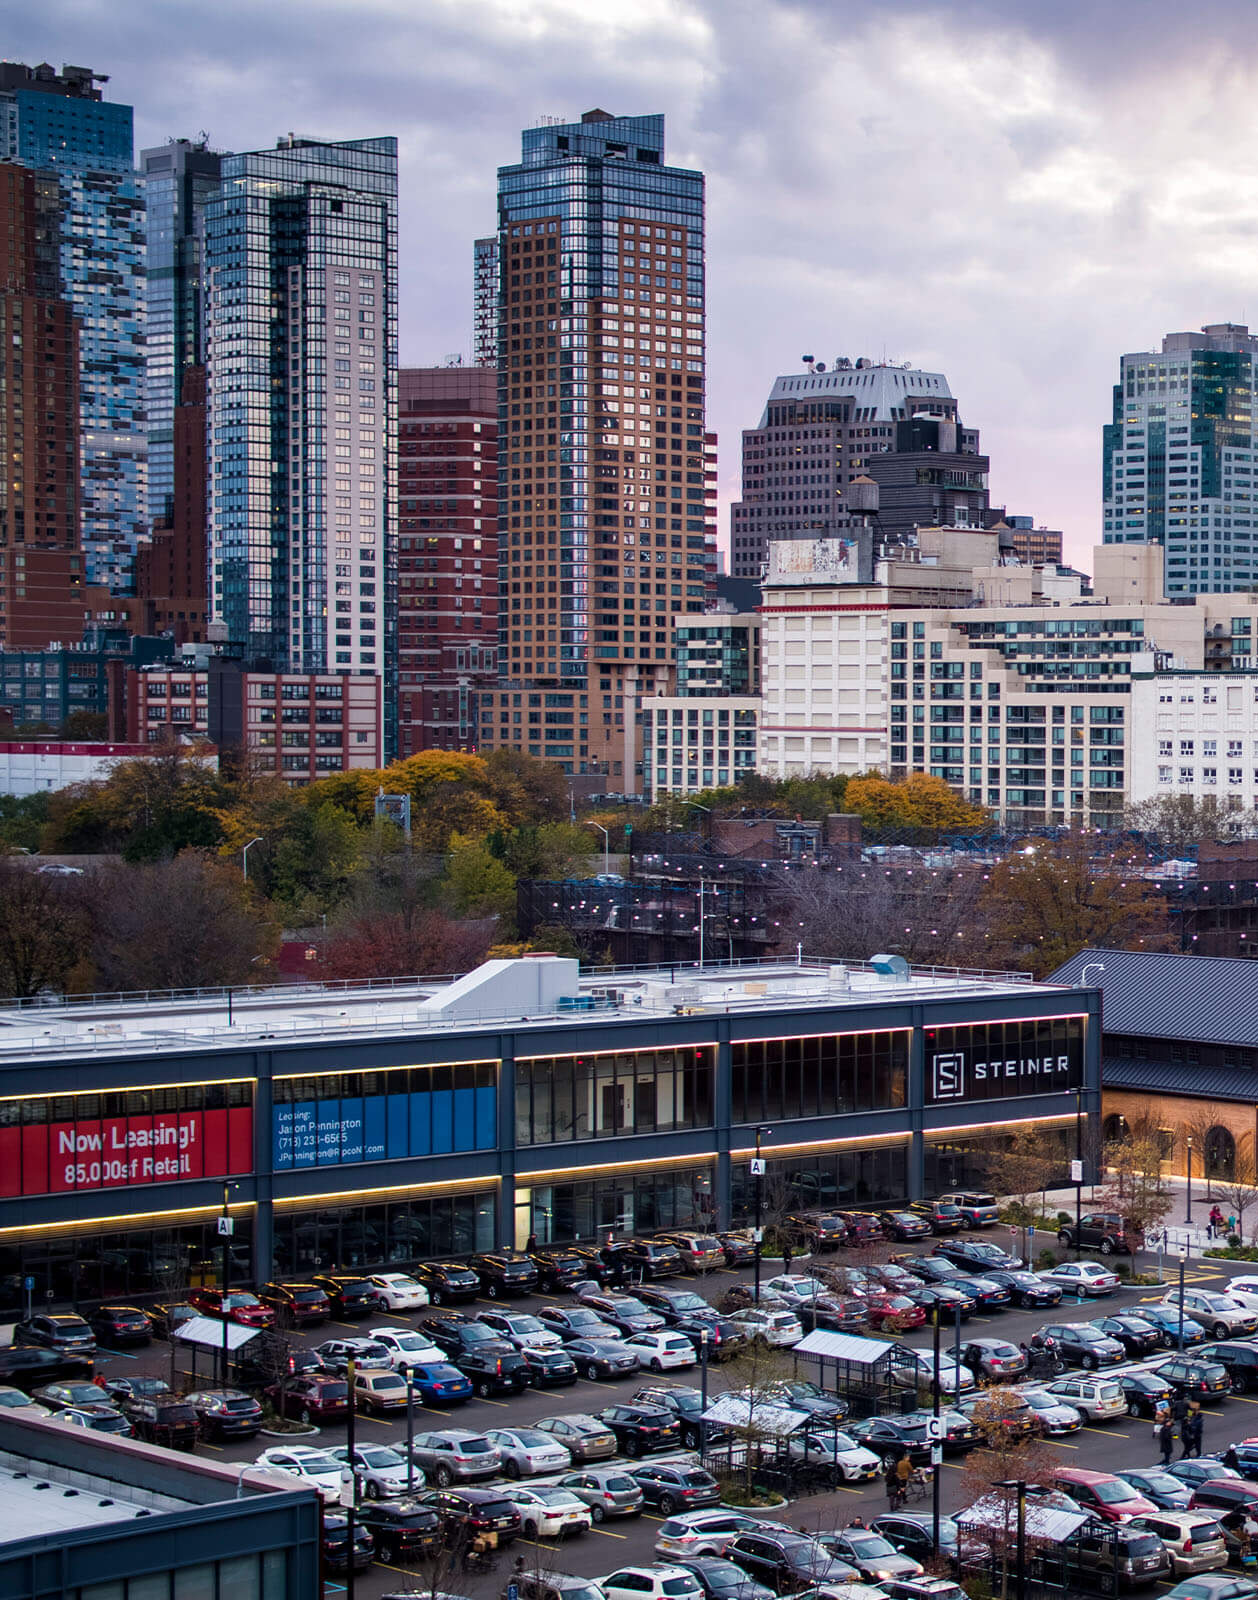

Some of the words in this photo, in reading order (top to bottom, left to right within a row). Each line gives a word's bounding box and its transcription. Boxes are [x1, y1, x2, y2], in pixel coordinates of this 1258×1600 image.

[975, 1056, 1069, 1079] STEINER
[59, 1130, 106, 1154] Now
[111, 1120, 196, 1149] Leasing!
[303, 1132, 348, 1146] 23-6565
[64, 1161, 138, 1184] 85,000sf
[142, 1154, 191, 1177] Retail
[752, 1161, 761, 1173] A
[219, 1219, 227, 1233] A
[929, 1419, 939, 1435] C
